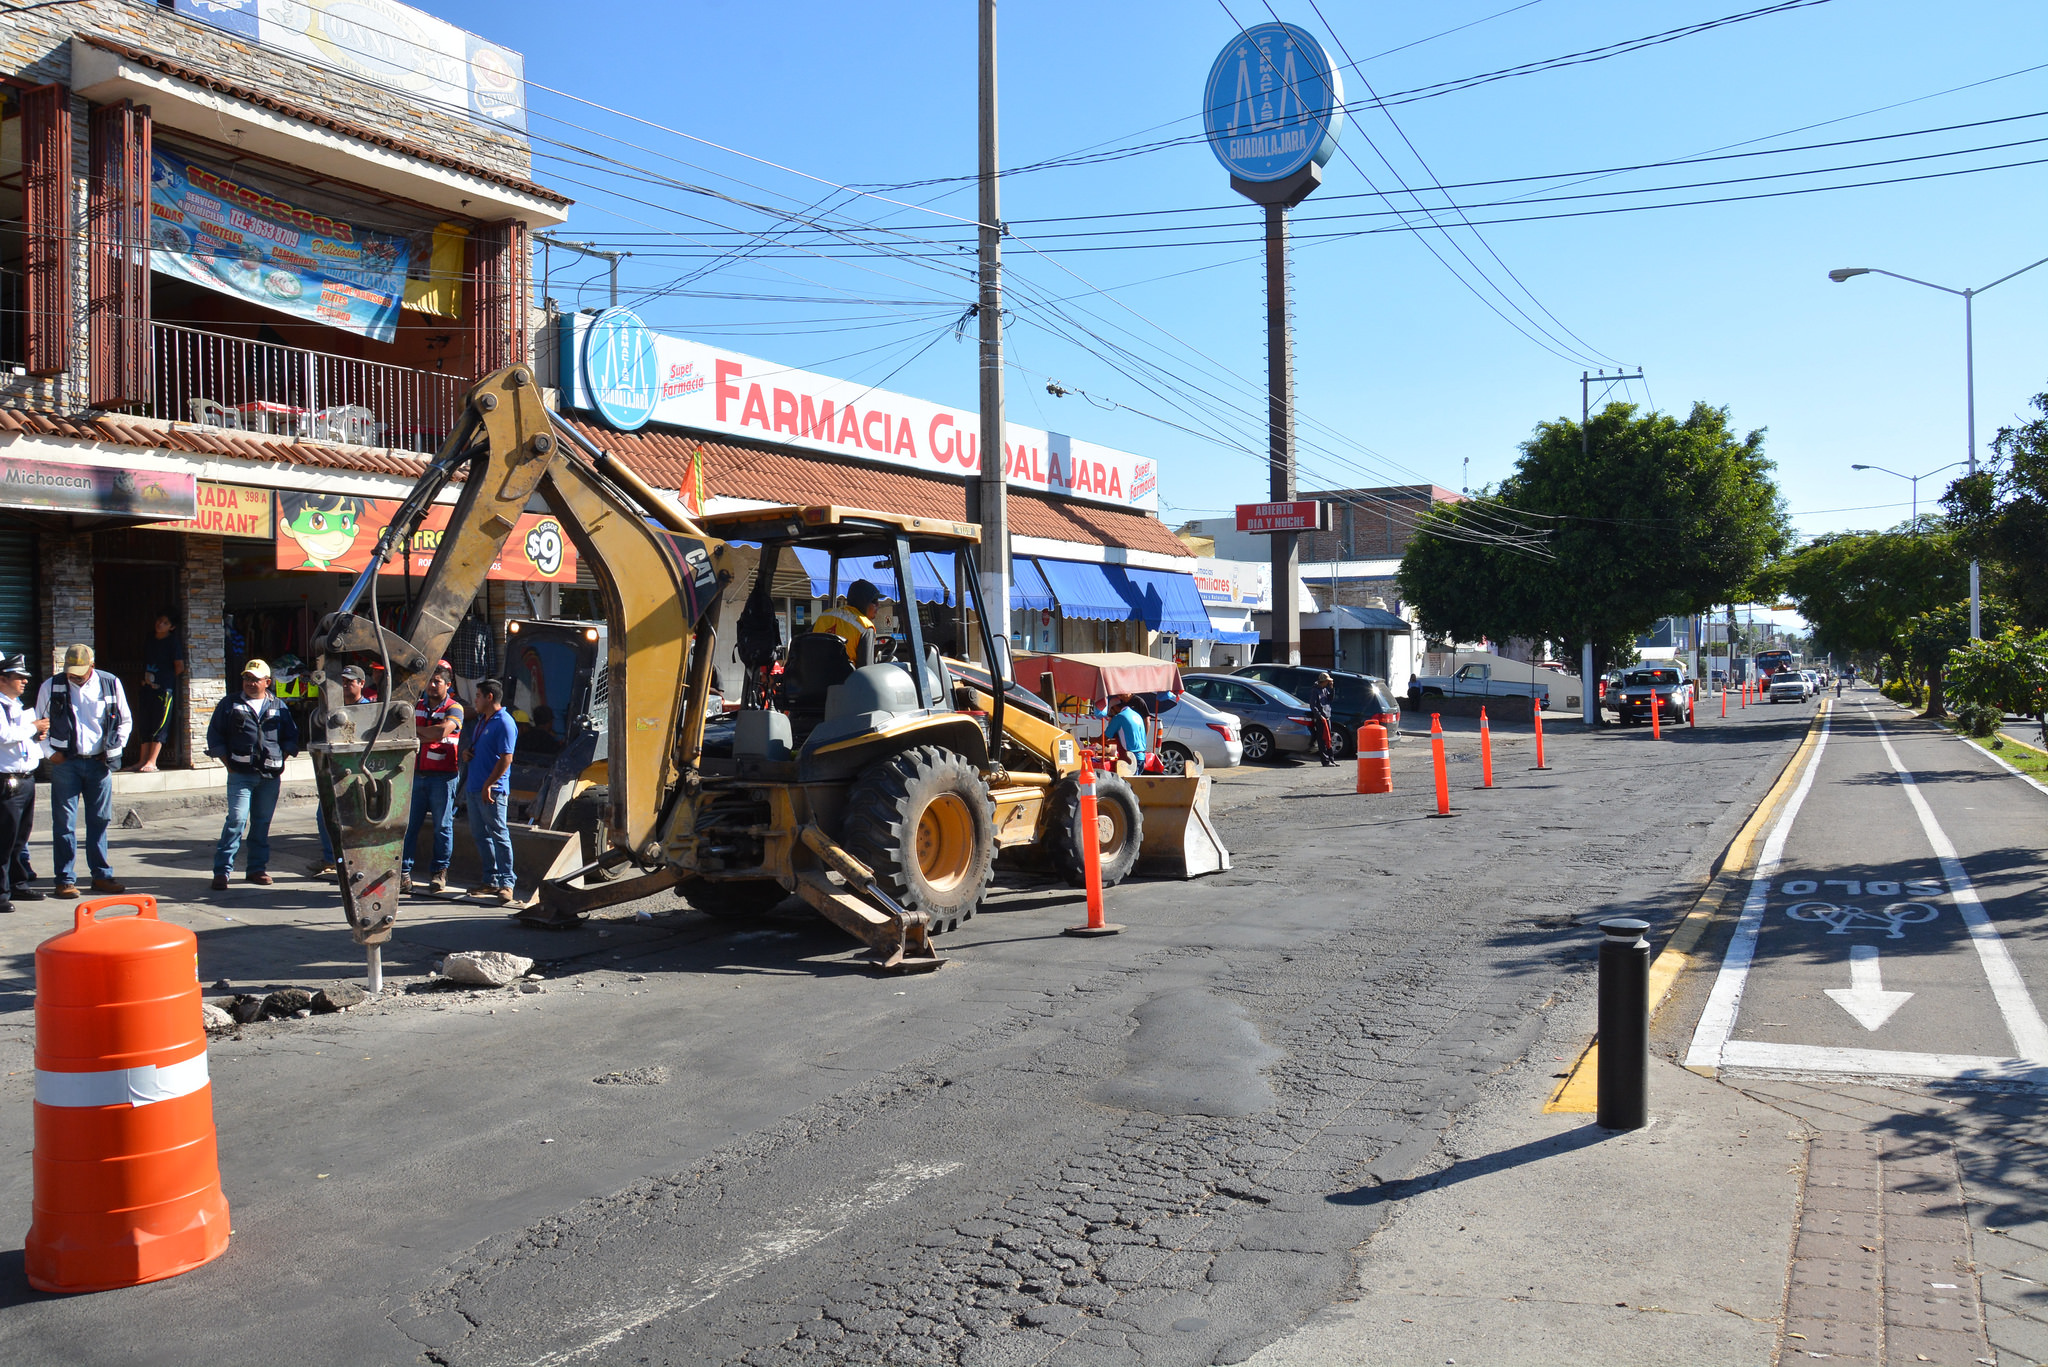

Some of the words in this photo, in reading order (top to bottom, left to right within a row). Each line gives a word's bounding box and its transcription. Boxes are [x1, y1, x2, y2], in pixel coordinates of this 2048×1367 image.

[1259, 36, 1275, 121] FARMACIAS
[1230, 129, 1307, 160] GUADALAJARA
[177, 199, 183, 208] A
[184, 201, 226, 224] DOMICILIO
[185, 191, 222, 211] SERVICIO
[186, 165, 354, 244] MARISCOS
[151, 202, 185, 224] TADAS
[199, 220, 244, 245] COCTELES
[274, 226, 300, 249] 8709
[311, 239, 361, 260] Deliciosas
[353, 287, 393, 308] MARISCOS
[620, 321, 630, 382] FARMACIAS
[670, 362, 694, 380] Super
[662, 373, 705, 399] Farmacia
[600, 386, 650, 411] GUADALAJARA
[714, 358, 917, 460] FARMACIA
[928, 412, 1124, 500] GUALAJARA
[4, 468, 92, 490] Michoacan
[1134, 462, 1151, 480] Super
[244, 490, 260, 504] 398
[260, 493, 268, 505] A
[1129, 472, 1157, 502] Farmacia
[1255, 503, 1295, 517] ABIERTO
[539, 522, 559, 533] DESDE
[1247, 516, 1264, 530] DIA
[1265, 516, 1273, 529] Y
[1274, 515, 1306, 529] NOCHE
[685, 548, 718, 588] CAT
[1194, 575, 1231, 593] amiliares
[1780, 878, 1946, 897] SOLO
